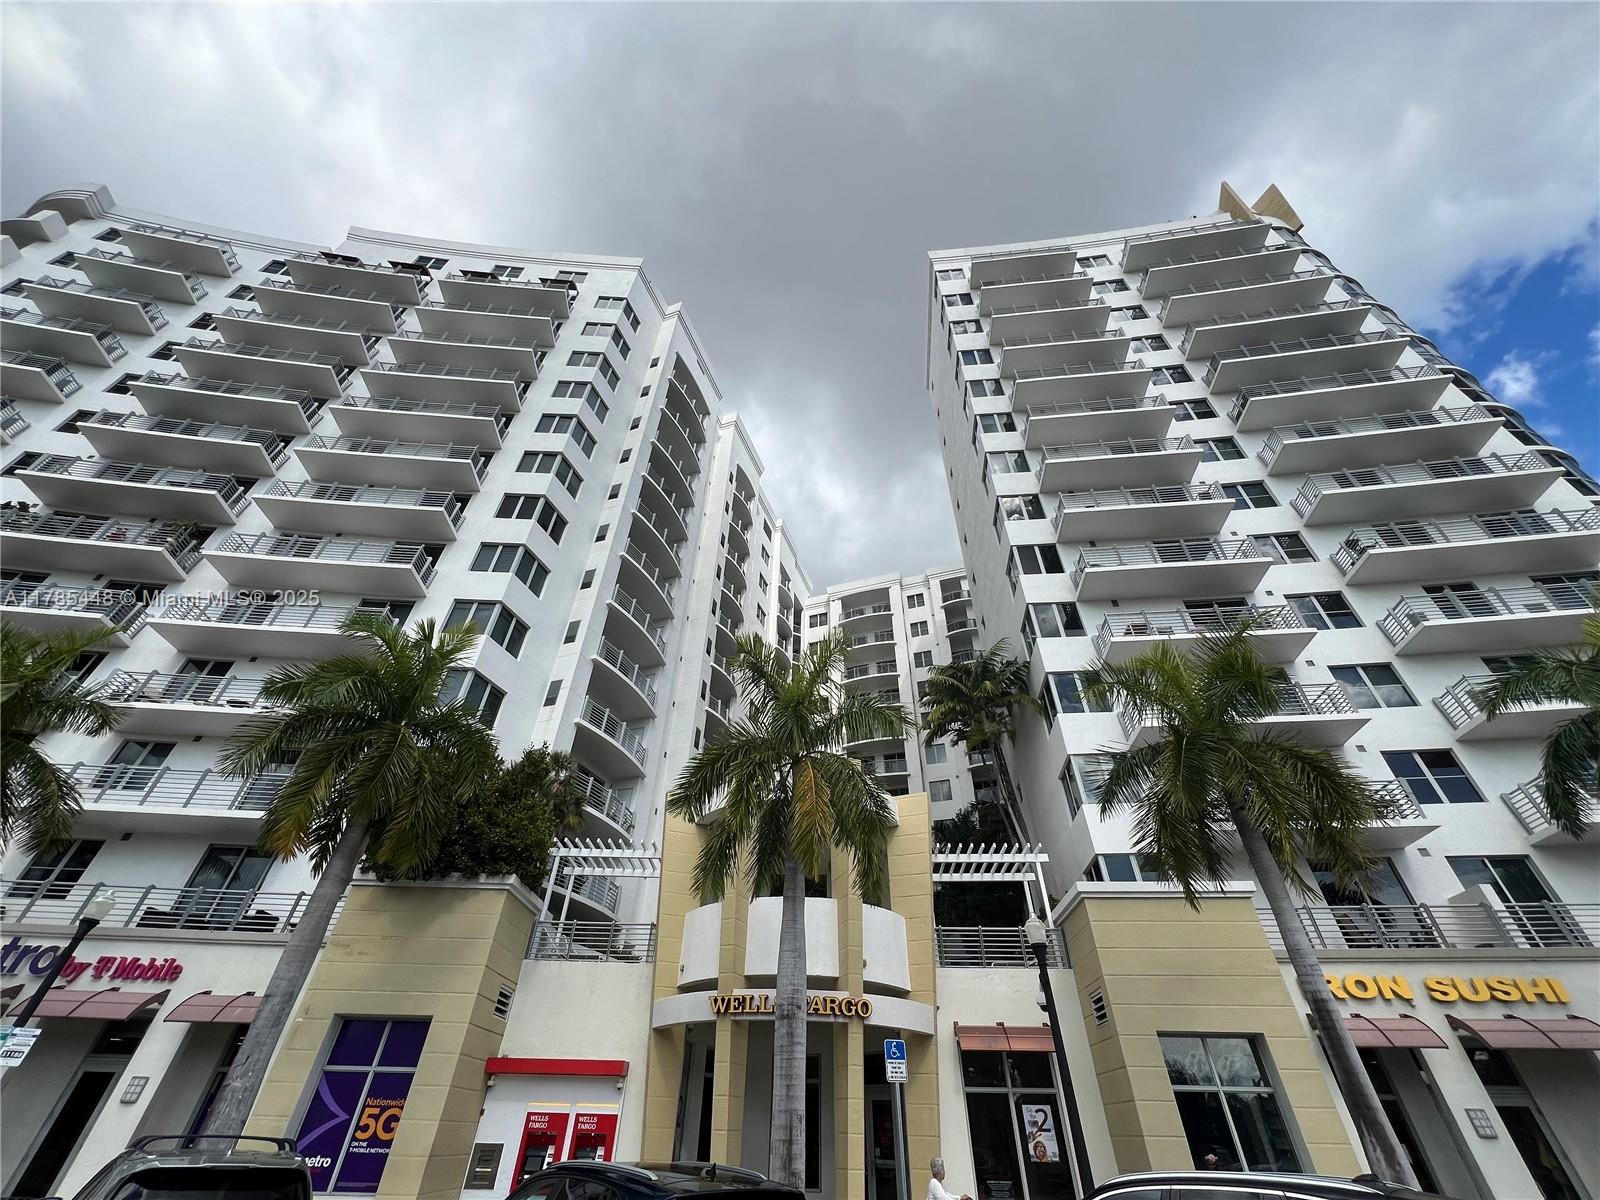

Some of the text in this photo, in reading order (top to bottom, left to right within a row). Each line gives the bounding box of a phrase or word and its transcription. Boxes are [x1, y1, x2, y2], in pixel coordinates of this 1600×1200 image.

[60, 955, 92, 984] by
[1424, 975, 1571, 1004] SUSHI
[708, 994, 776, 1014] WELL
[365, 1097, 406, 1107] Nationwid
[354, 1107, 402, 1141] 5G
[1034, 1107, 1051, 1132] 2
